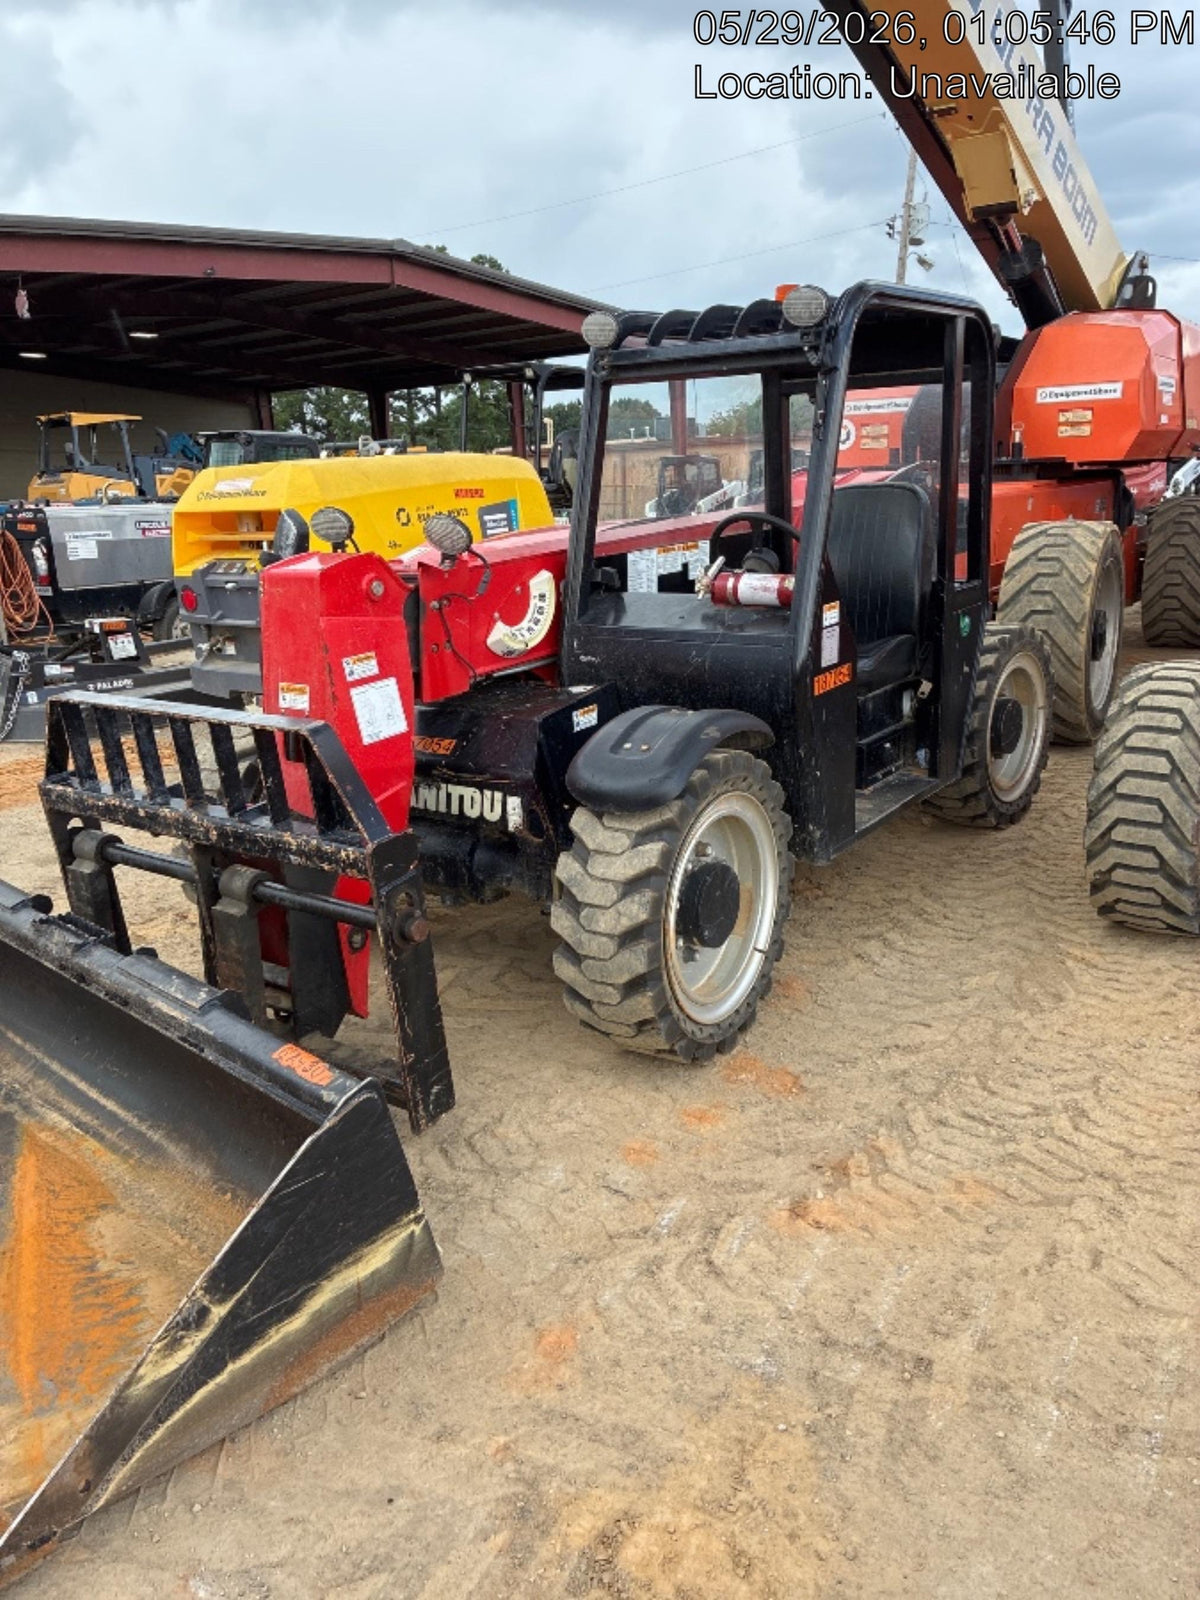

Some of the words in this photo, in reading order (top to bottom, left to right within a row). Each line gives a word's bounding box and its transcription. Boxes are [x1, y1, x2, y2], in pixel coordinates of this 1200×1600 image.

[1048, 387, 1118, 399] EquipmentShare
[415, 739, 454, 753] 7054
[411, 782, 503, 822] NITOU
